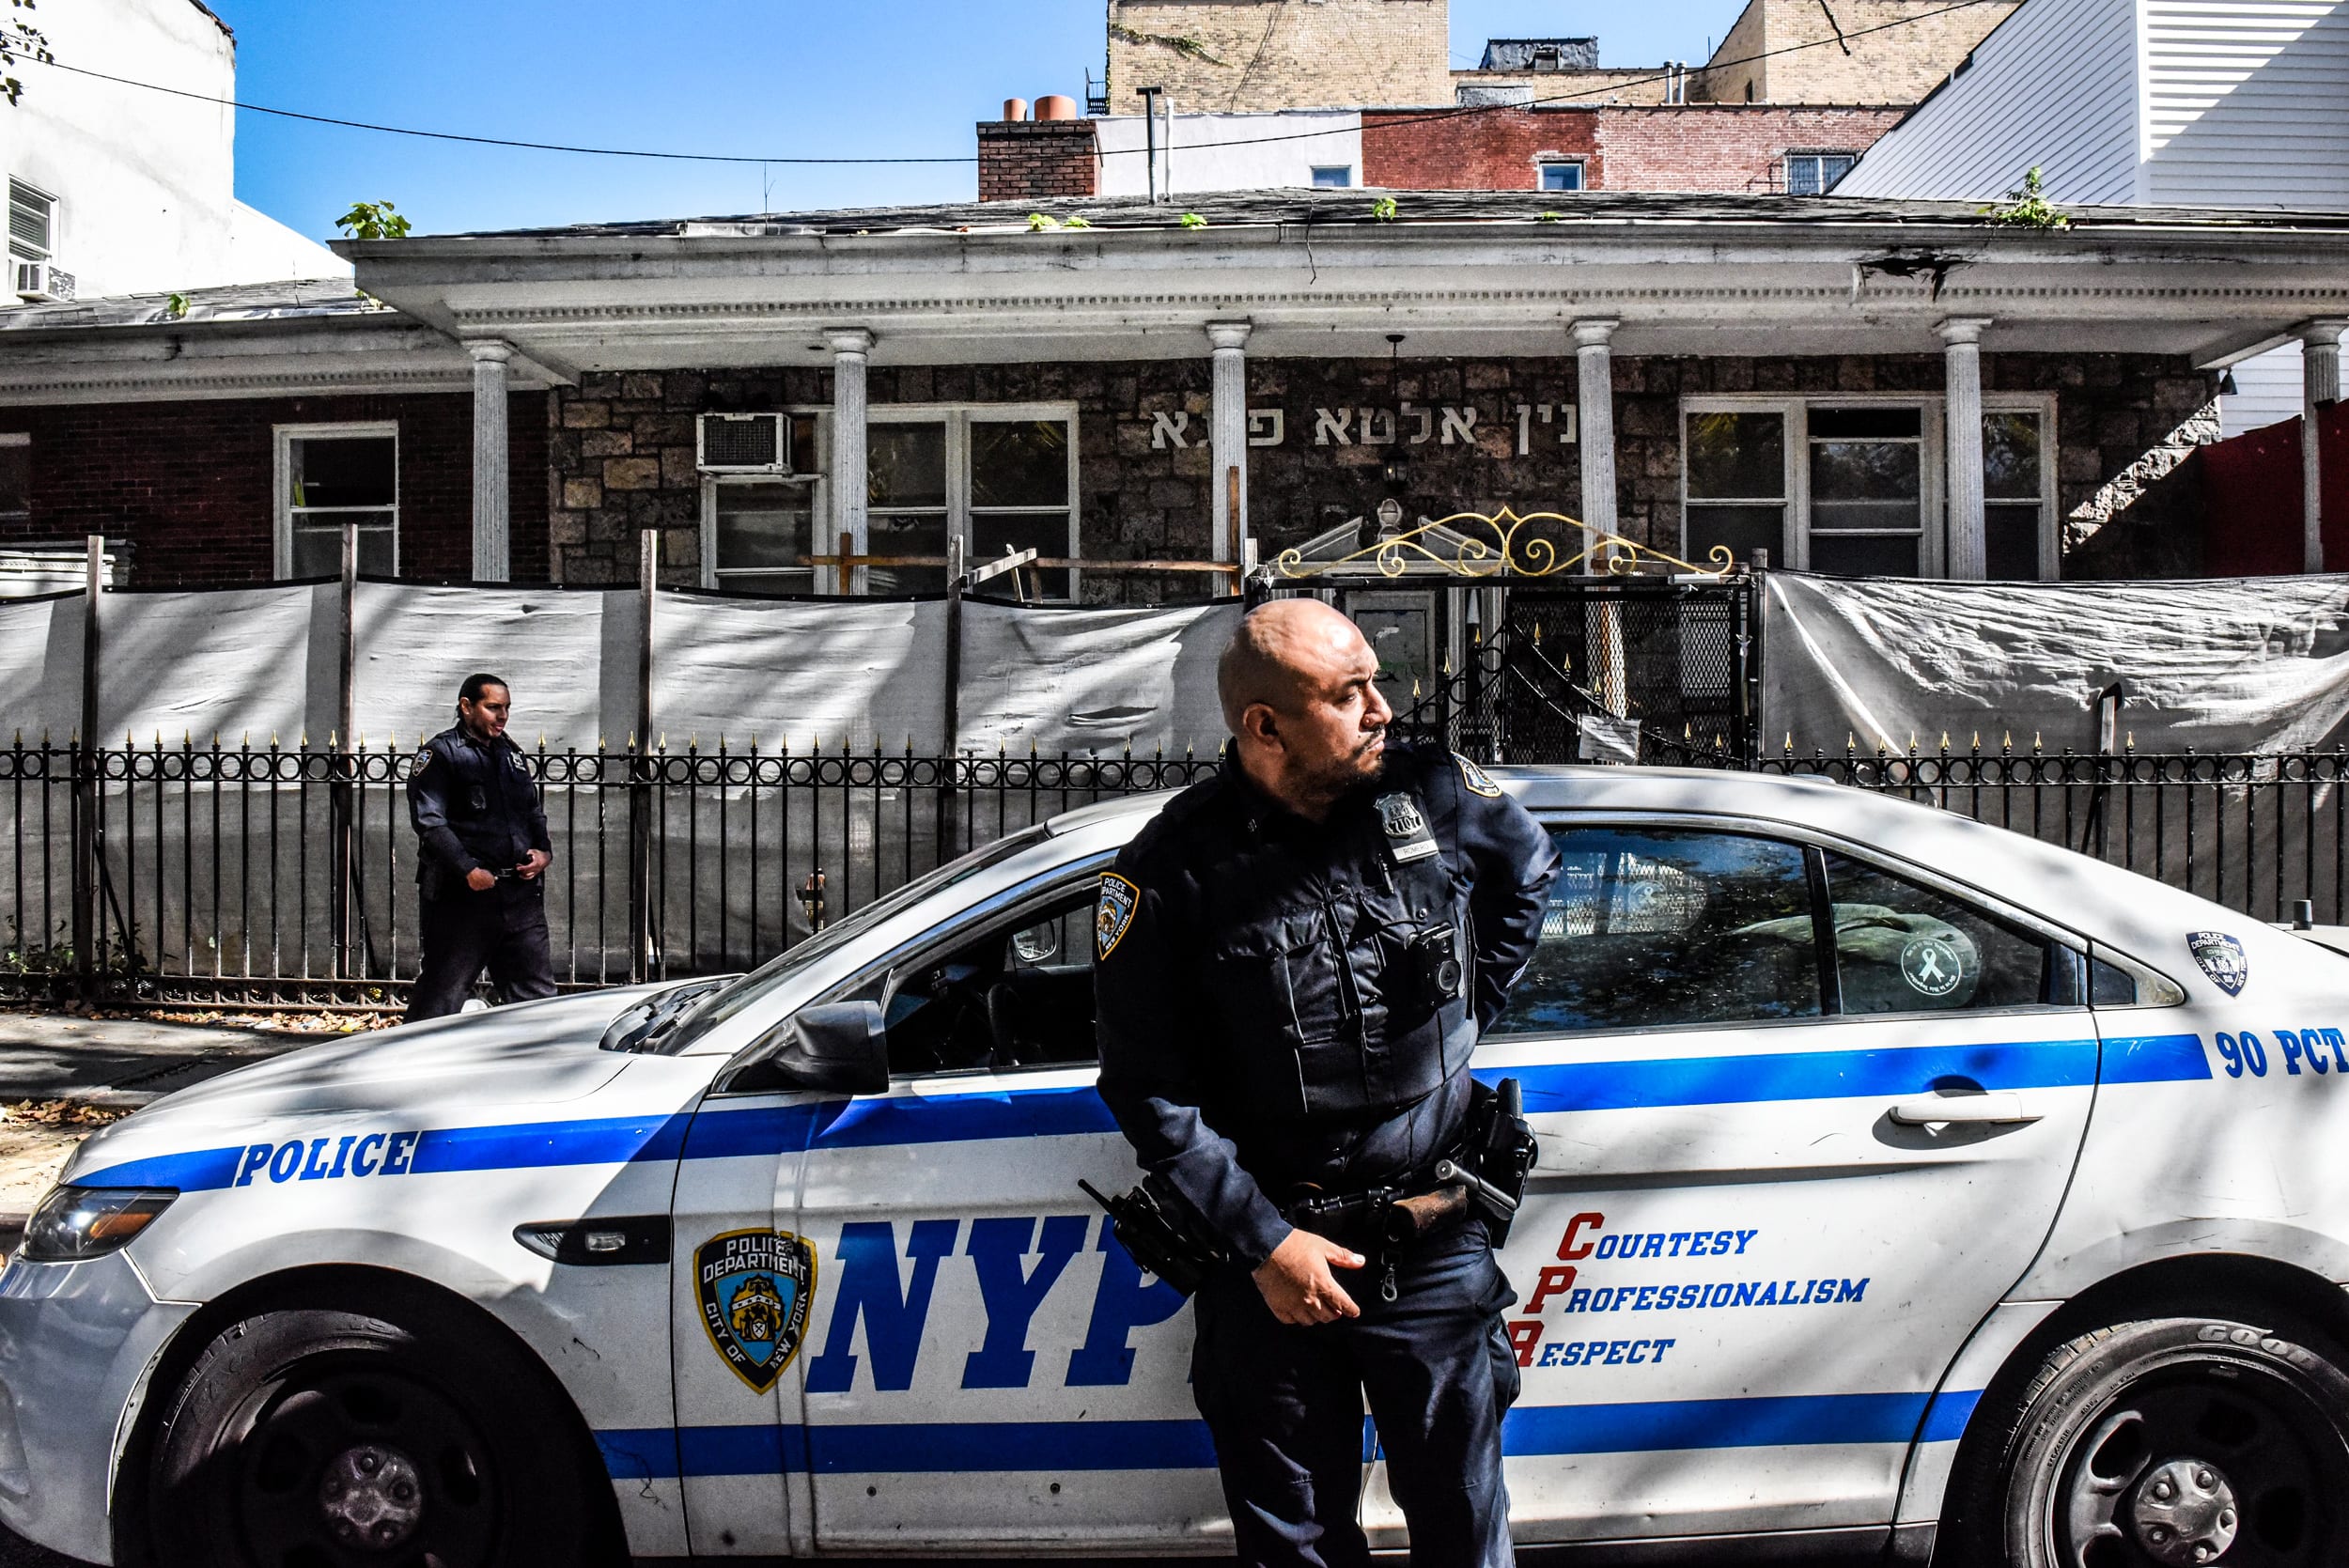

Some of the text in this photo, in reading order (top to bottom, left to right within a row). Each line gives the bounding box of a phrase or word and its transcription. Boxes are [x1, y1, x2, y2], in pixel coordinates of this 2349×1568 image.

[1315, 402, 1477, 445] אלטא
[1101, 886, 1132, 908] PARTMENT
[1104, 877, 1126, 893] POLICE
[1115, 913, 1129, 937] YORK
[2191, 939, 2240, 952] DEPARTMENT
[2195, 955, 2211, 972] CITY
[2209, 974, 2221, 984] OF
[2215, 1028, 2349, 1079] 90 PCT
[235, 1131, 419, 1188] POLICE
[725, 1236, 786, 1257] POLICE
[804, 1215, 1194, 1393] NYP
[706, 1291, 808, 1369] CITY OF NEW YORK
